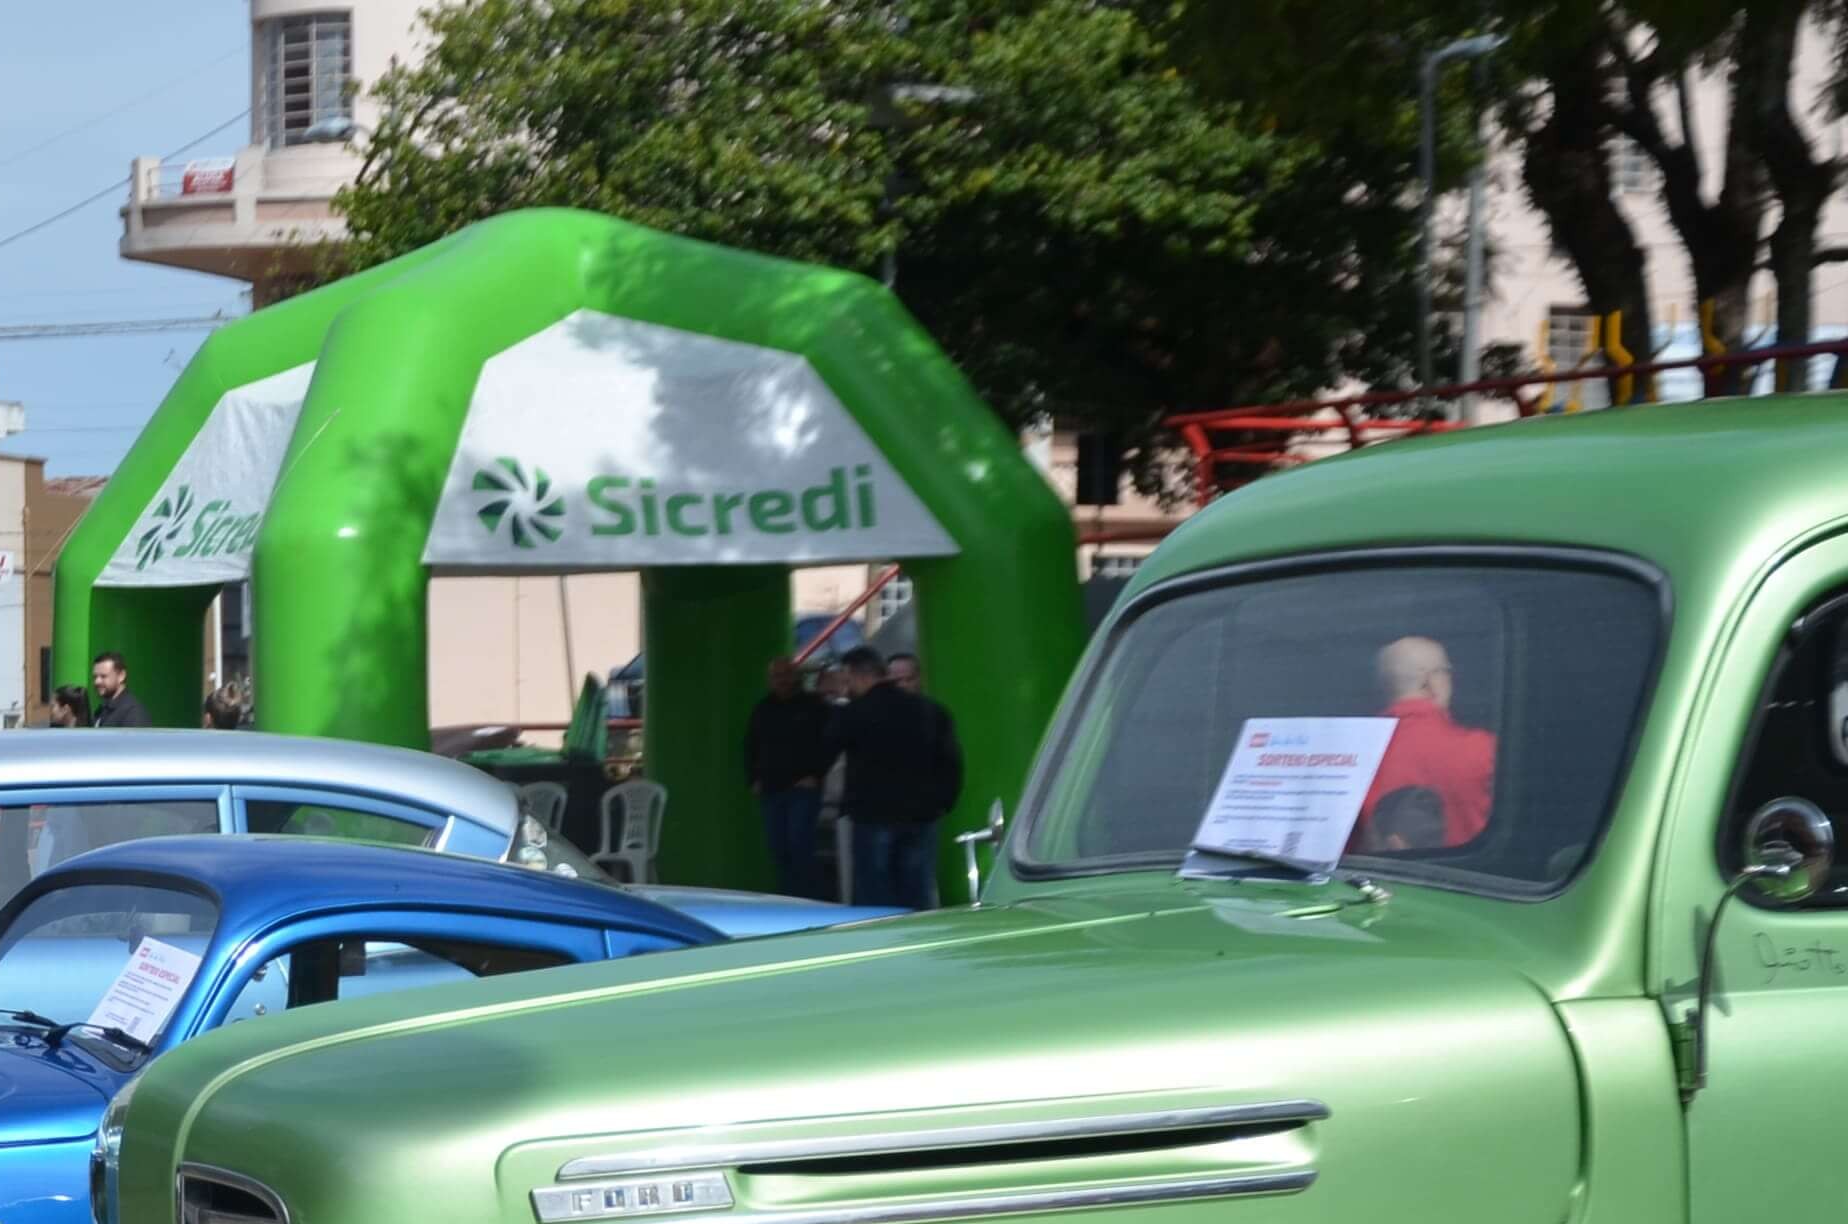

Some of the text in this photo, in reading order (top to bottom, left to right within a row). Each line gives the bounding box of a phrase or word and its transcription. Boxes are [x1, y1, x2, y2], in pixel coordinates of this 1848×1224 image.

[172, 499, 262, 557] Sicre
[585, 463, 877, 537] Sicredi
[570, 1181, 695, 1213] FORD
